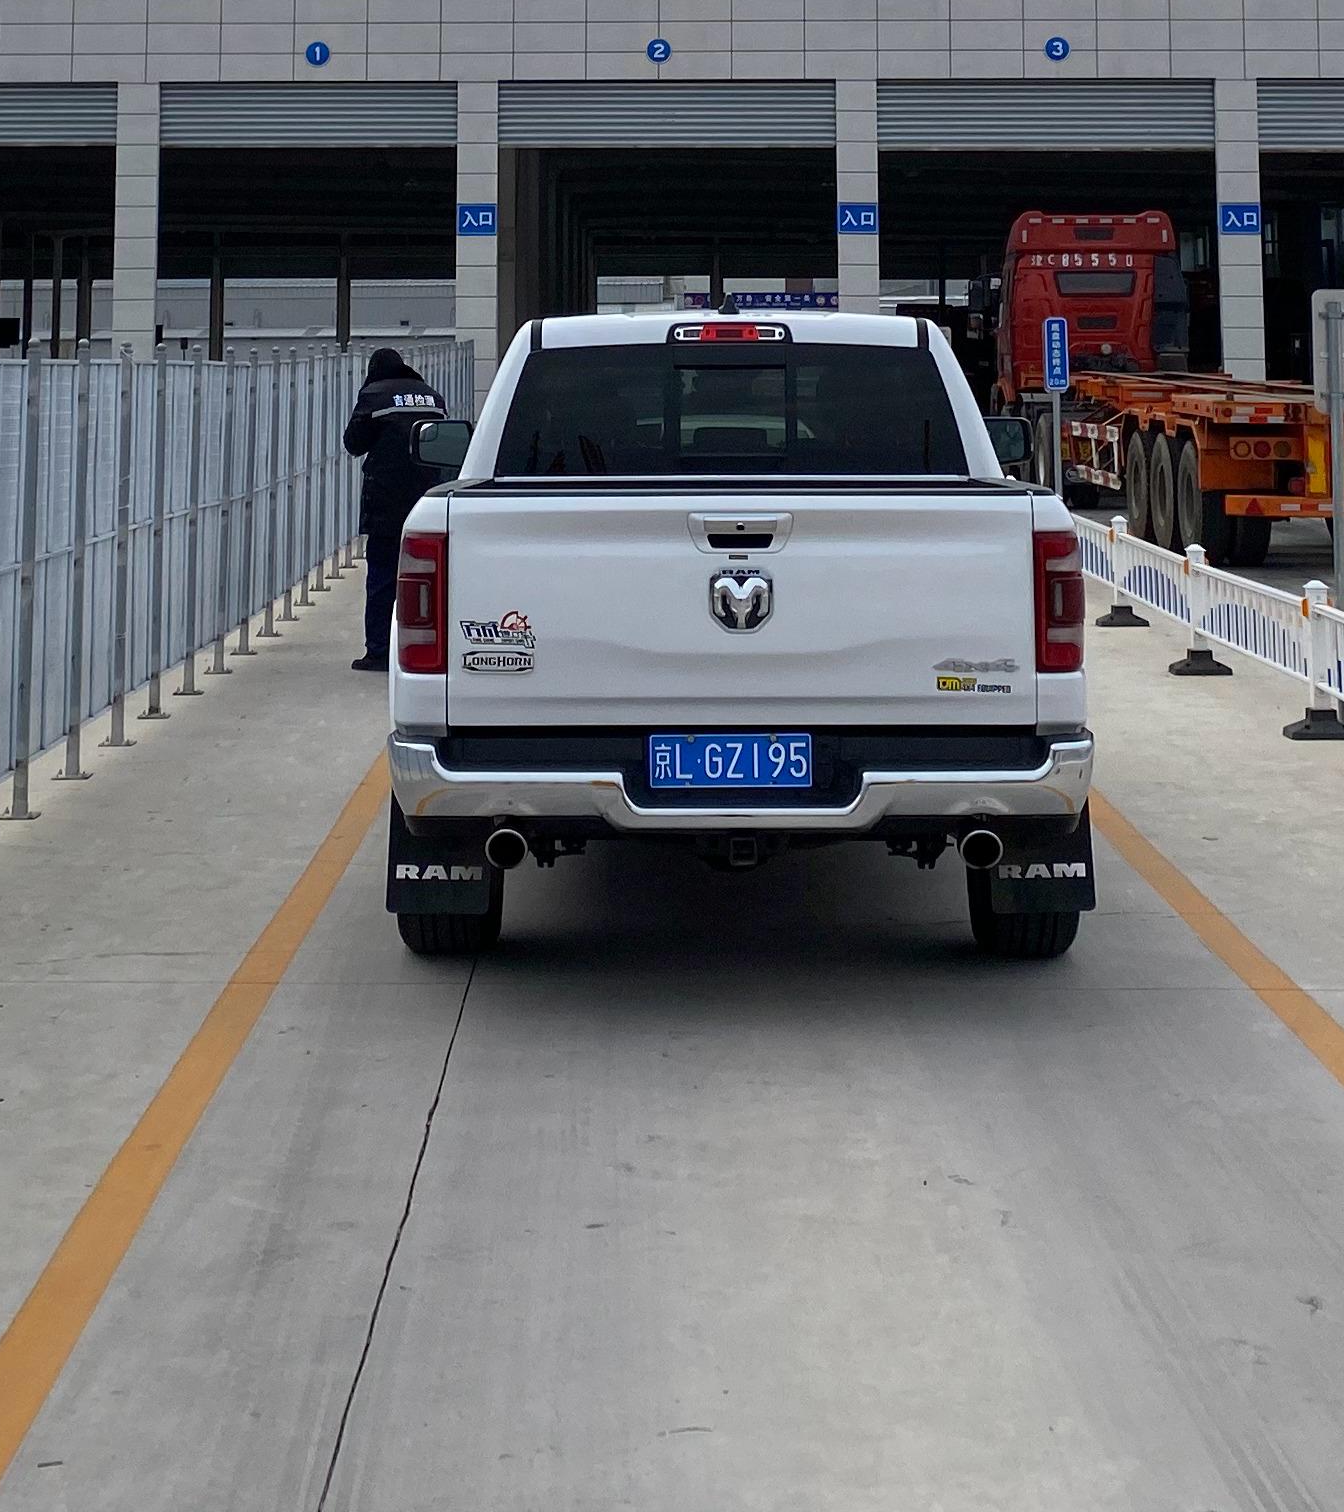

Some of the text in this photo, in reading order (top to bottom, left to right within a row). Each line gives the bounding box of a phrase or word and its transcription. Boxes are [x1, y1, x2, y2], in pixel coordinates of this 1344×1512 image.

[653, 44, 666, 58] 2
[1051, 41, 1064, 56] 3
[462, 210, 493, 227] 入口
[842, 210, 875, 227] 入口
[1225, 211, 1258, 227] 入口
[396, 864, 483, 881] RAM
[998, 862, 1086, 880] RAM
